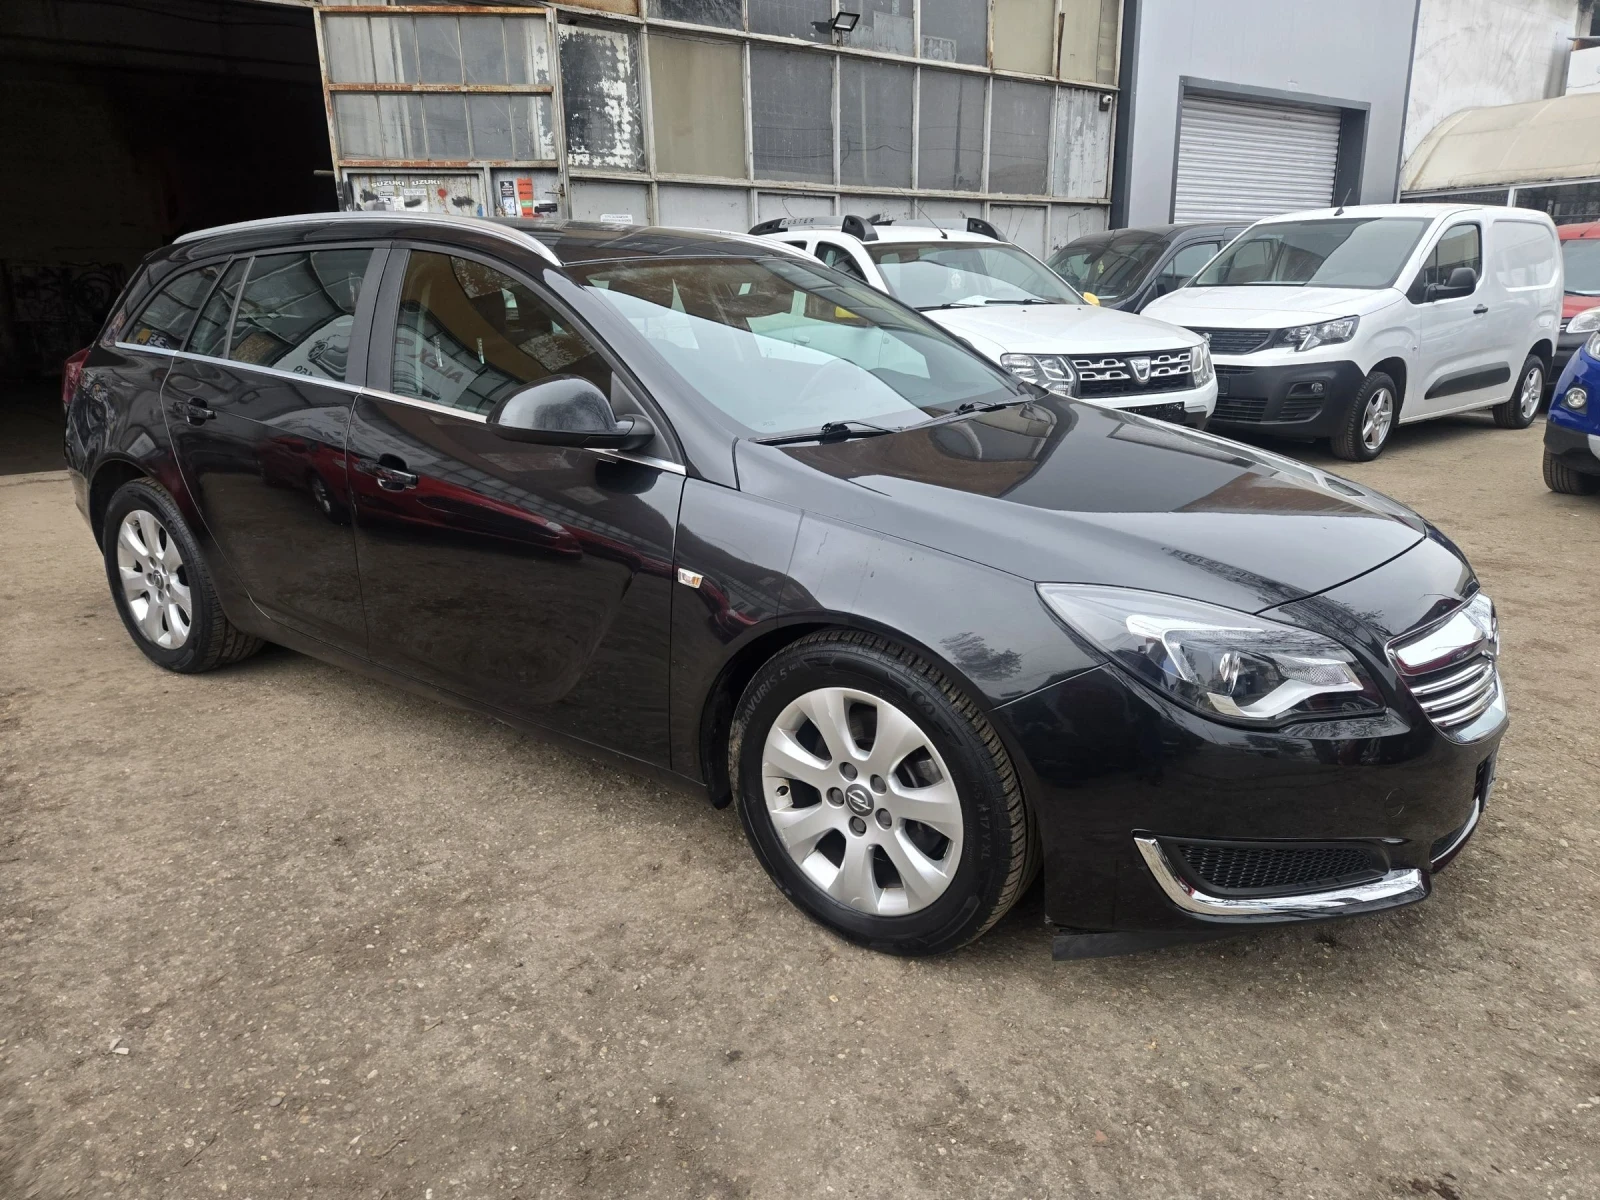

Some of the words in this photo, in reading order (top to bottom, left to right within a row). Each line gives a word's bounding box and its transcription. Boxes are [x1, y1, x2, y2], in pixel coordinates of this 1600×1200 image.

[741, 674, 778, 734] RAVURIS
[779, 667, 788, 681] 5
[980, 844, 992, 859] XL
